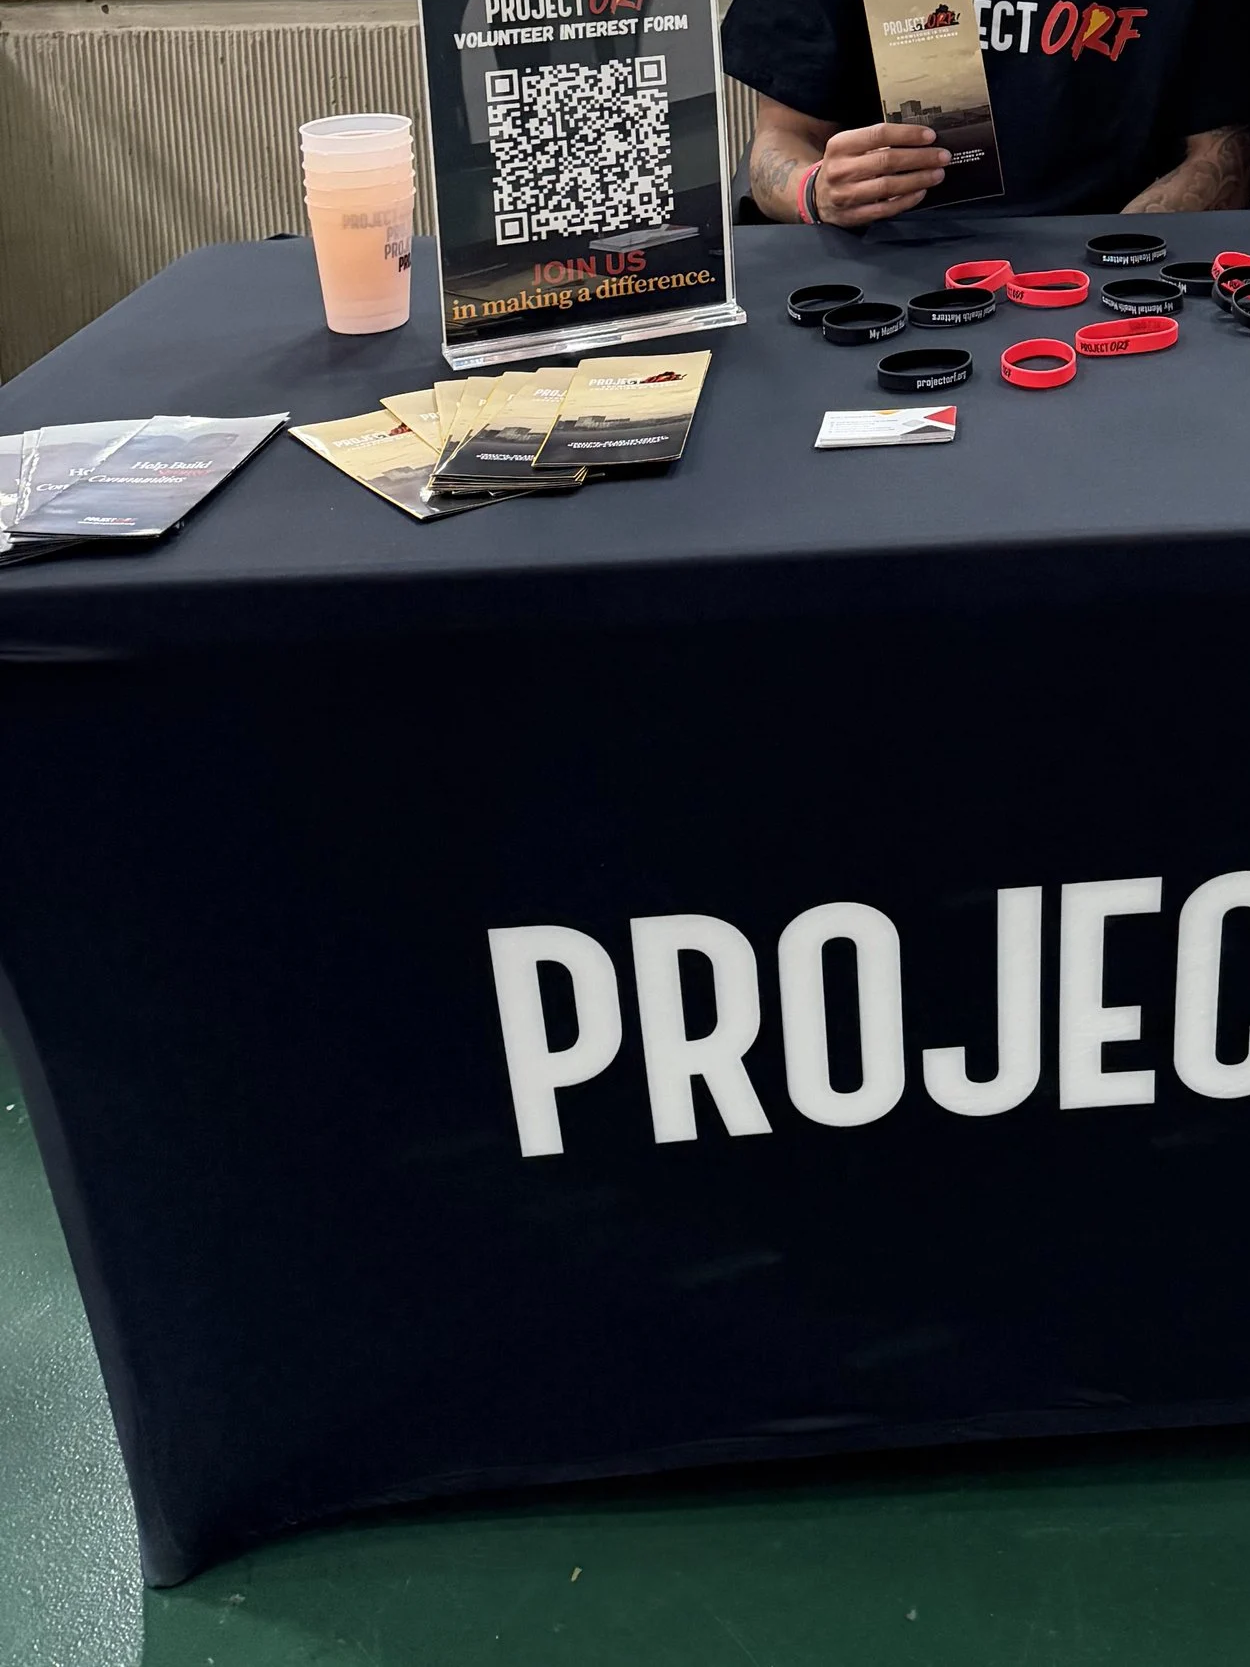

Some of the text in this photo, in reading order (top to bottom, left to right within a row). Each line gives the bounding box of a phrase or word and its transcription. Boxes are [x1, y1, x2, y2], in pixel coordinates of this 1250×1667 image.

[454, 14, 689, 50] VOLUNTEER INTEREST FORM
[882, 16, 926, 36] PROJECT
[1041, 0, 1149, 62] ORF
[532, 249, 648, 287] JOIN US
[452, 268, 717, 321] in making a difference.
[932, 312, 962, 324] Matters
[1138, 305, 1163, 315] Mental
[869, 329, 880, 340] My
[1080, 339, 1131, 353] PROJECT ORF
[916, 370, 968, 390] projectorf.org
[130, 460, 213, 471] Help Build
[88, 475, 187, 484] Communities
